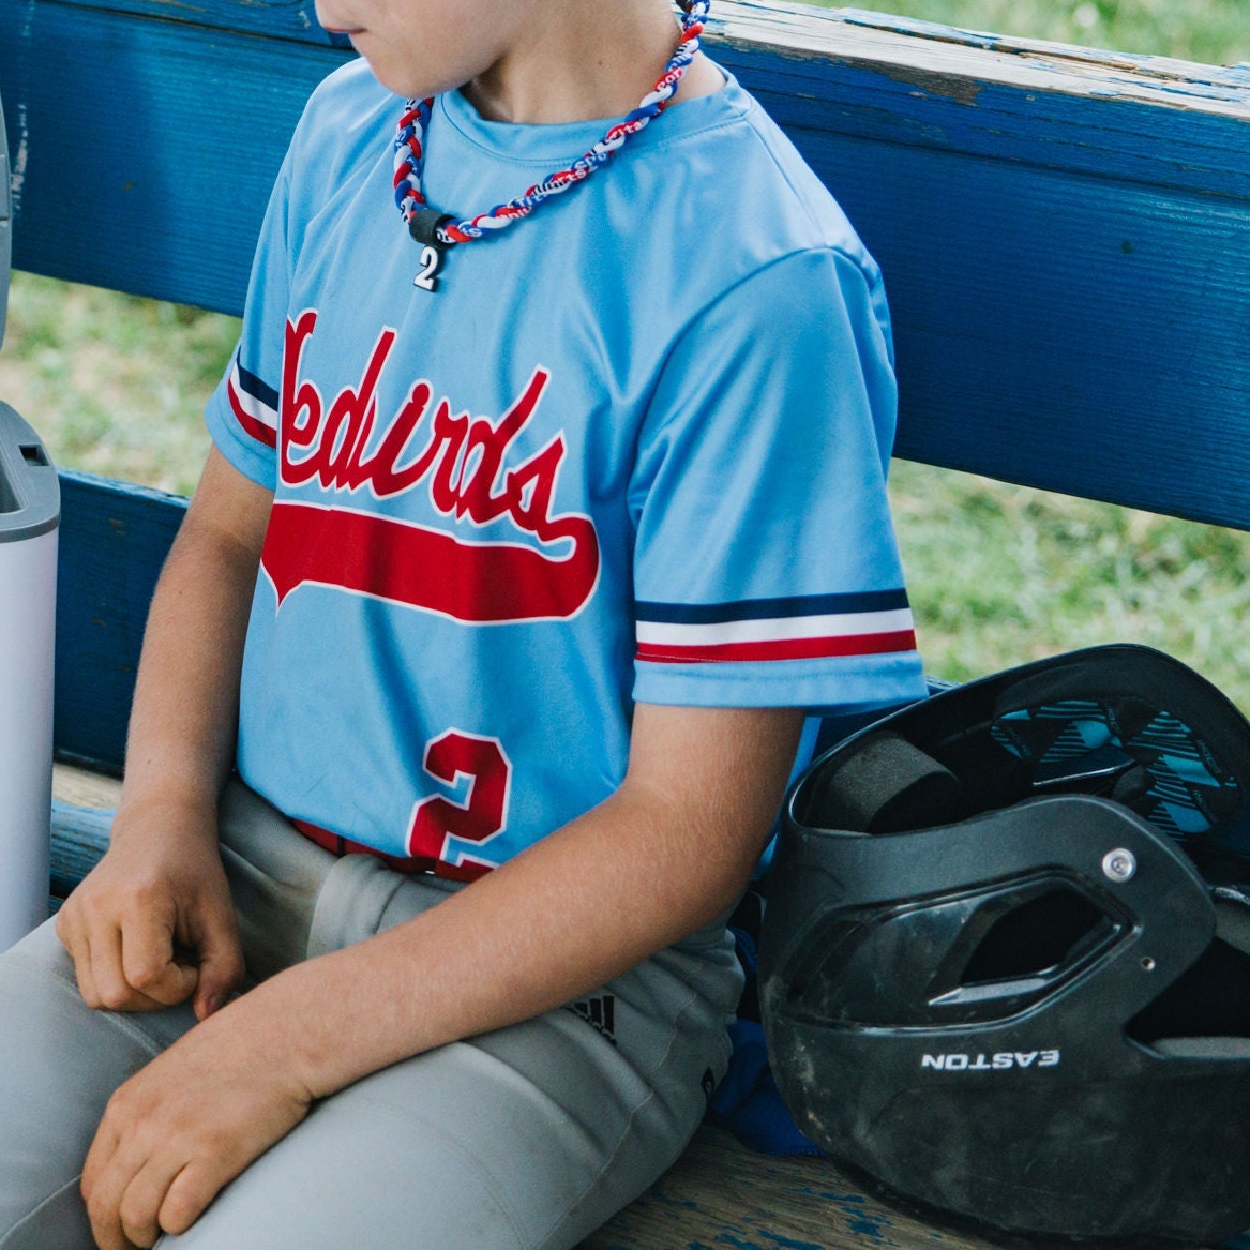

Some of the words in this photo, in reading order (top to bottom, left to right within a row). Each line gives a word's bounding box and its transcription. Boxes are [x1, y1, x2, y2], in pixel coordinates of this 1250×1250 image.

[414, 245, 439, 292] 2
[282, 307, 568, 541] edirds
[405, 726, 513, 883] 2
[921, 1049, 1061, 1071] EASTON
